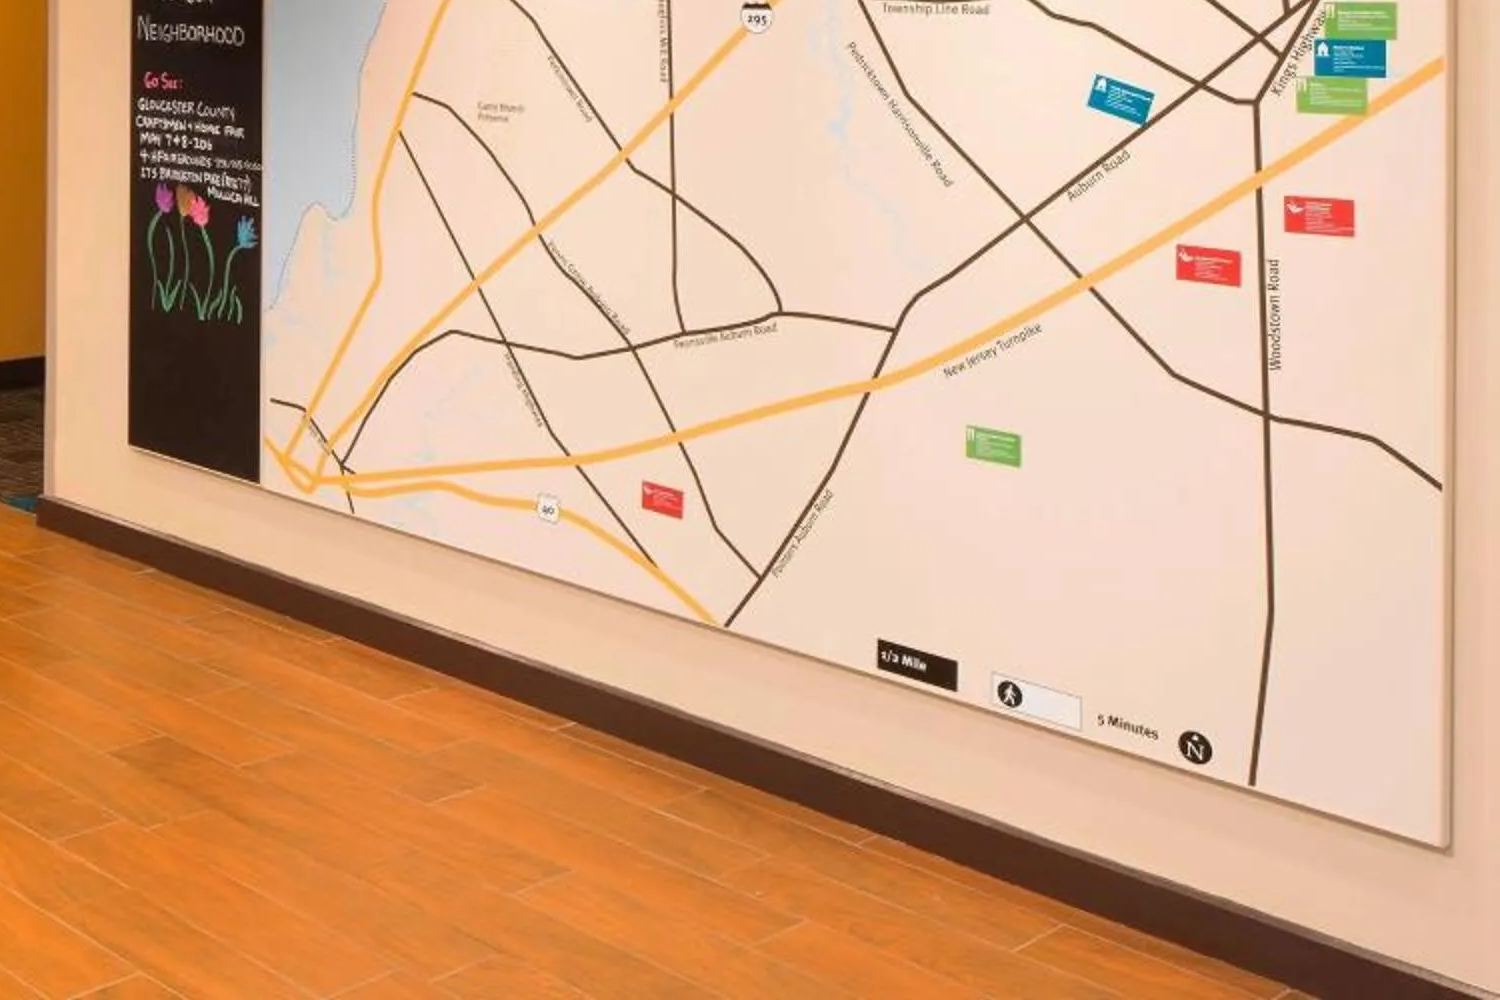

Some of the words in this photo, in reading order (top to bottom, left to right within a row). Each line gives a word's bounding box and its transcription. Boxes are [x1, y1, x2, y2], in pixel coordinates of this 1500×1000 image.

[747, 14, 767, 26] 295
[961, 2, 991, 16] Road
[137, 14, 246, 47] NEIGHBORHOOD
[1271, 62, 1299, 98] Kings
[930, 159, 955, 188] Road
[1067, 171, 1105, 202] Auburn
[1102, 149, 1132, 174] Road
[1266, 258, 1280, 292] Road
[1268, 294, 1282, 372] Woodstown
[943, 362, 966, 378] New
[965, 347, 998, 369] Jersey
[996, 323, 1043, 353] Turnpike
[901, 653, 927, 671] Mile
[1097, 713, 1106, 727] 5
[1107, 714, 1160, 741] Minutes
